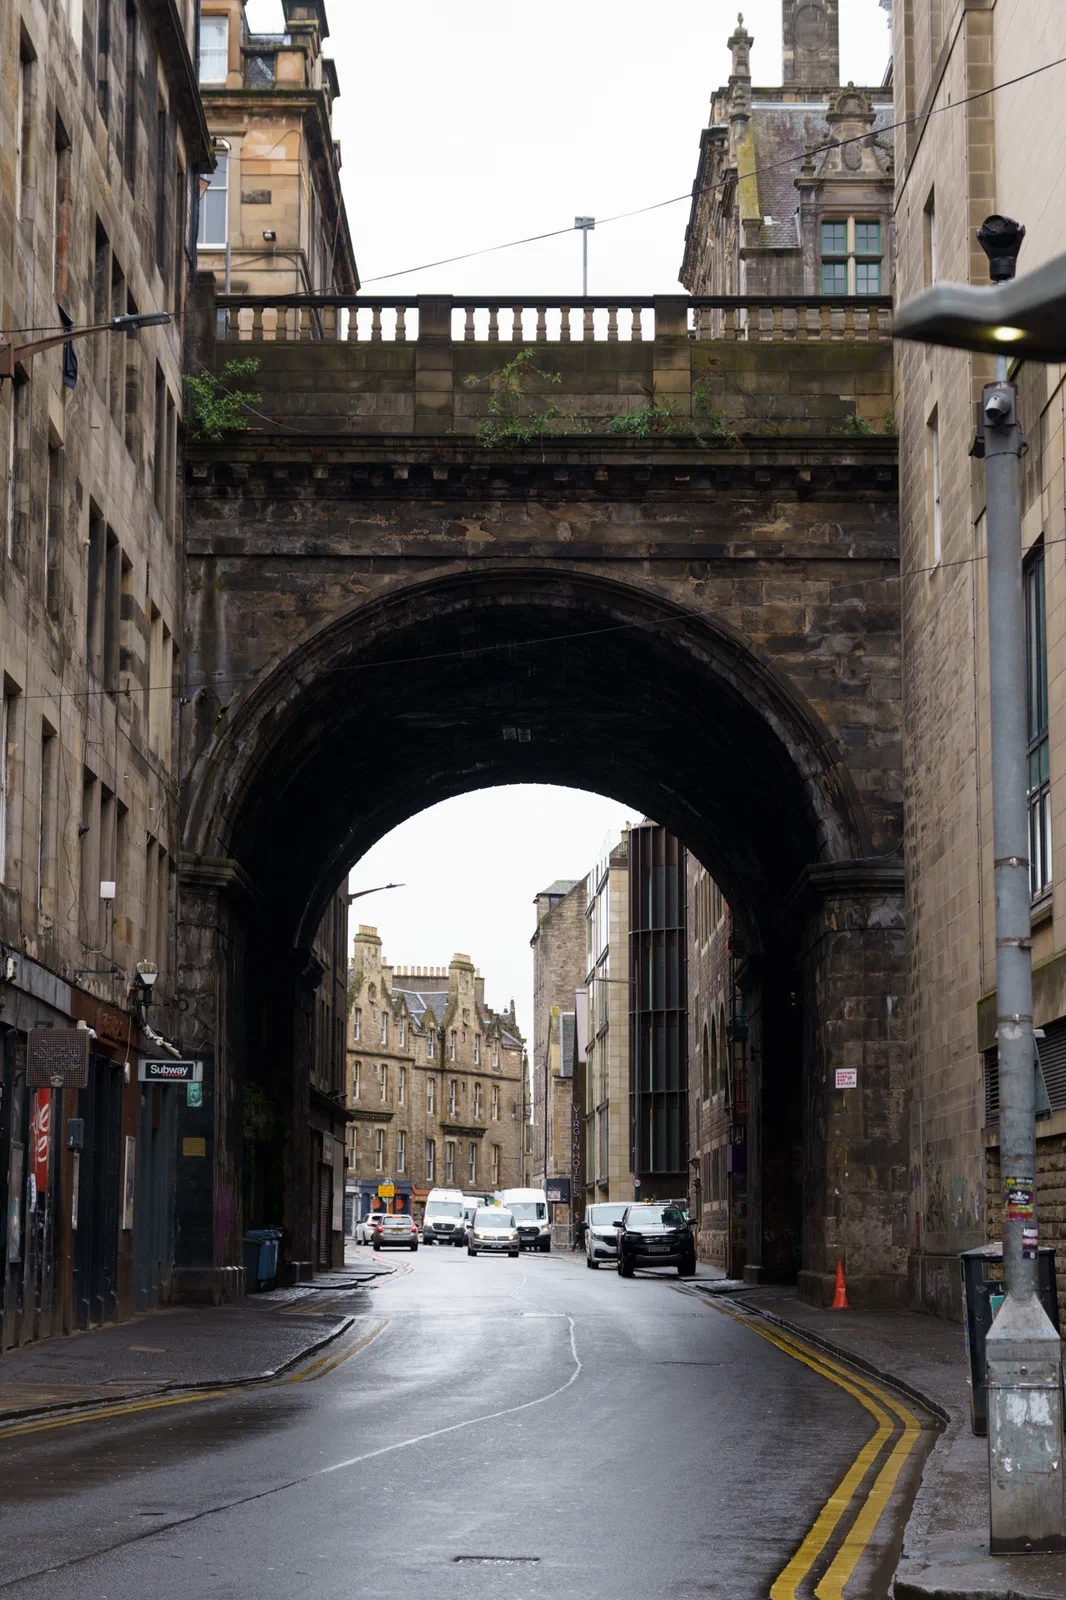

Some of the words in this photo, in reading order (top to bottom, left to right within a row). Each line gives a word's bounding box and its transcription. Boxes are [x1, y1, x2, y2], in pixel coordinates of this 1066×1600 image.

[150, 1064, 188, 1076] Subway
[572, 1105, 581, 1150] VIRGIN
[572, 1153, 581, 1197] HOTELS
